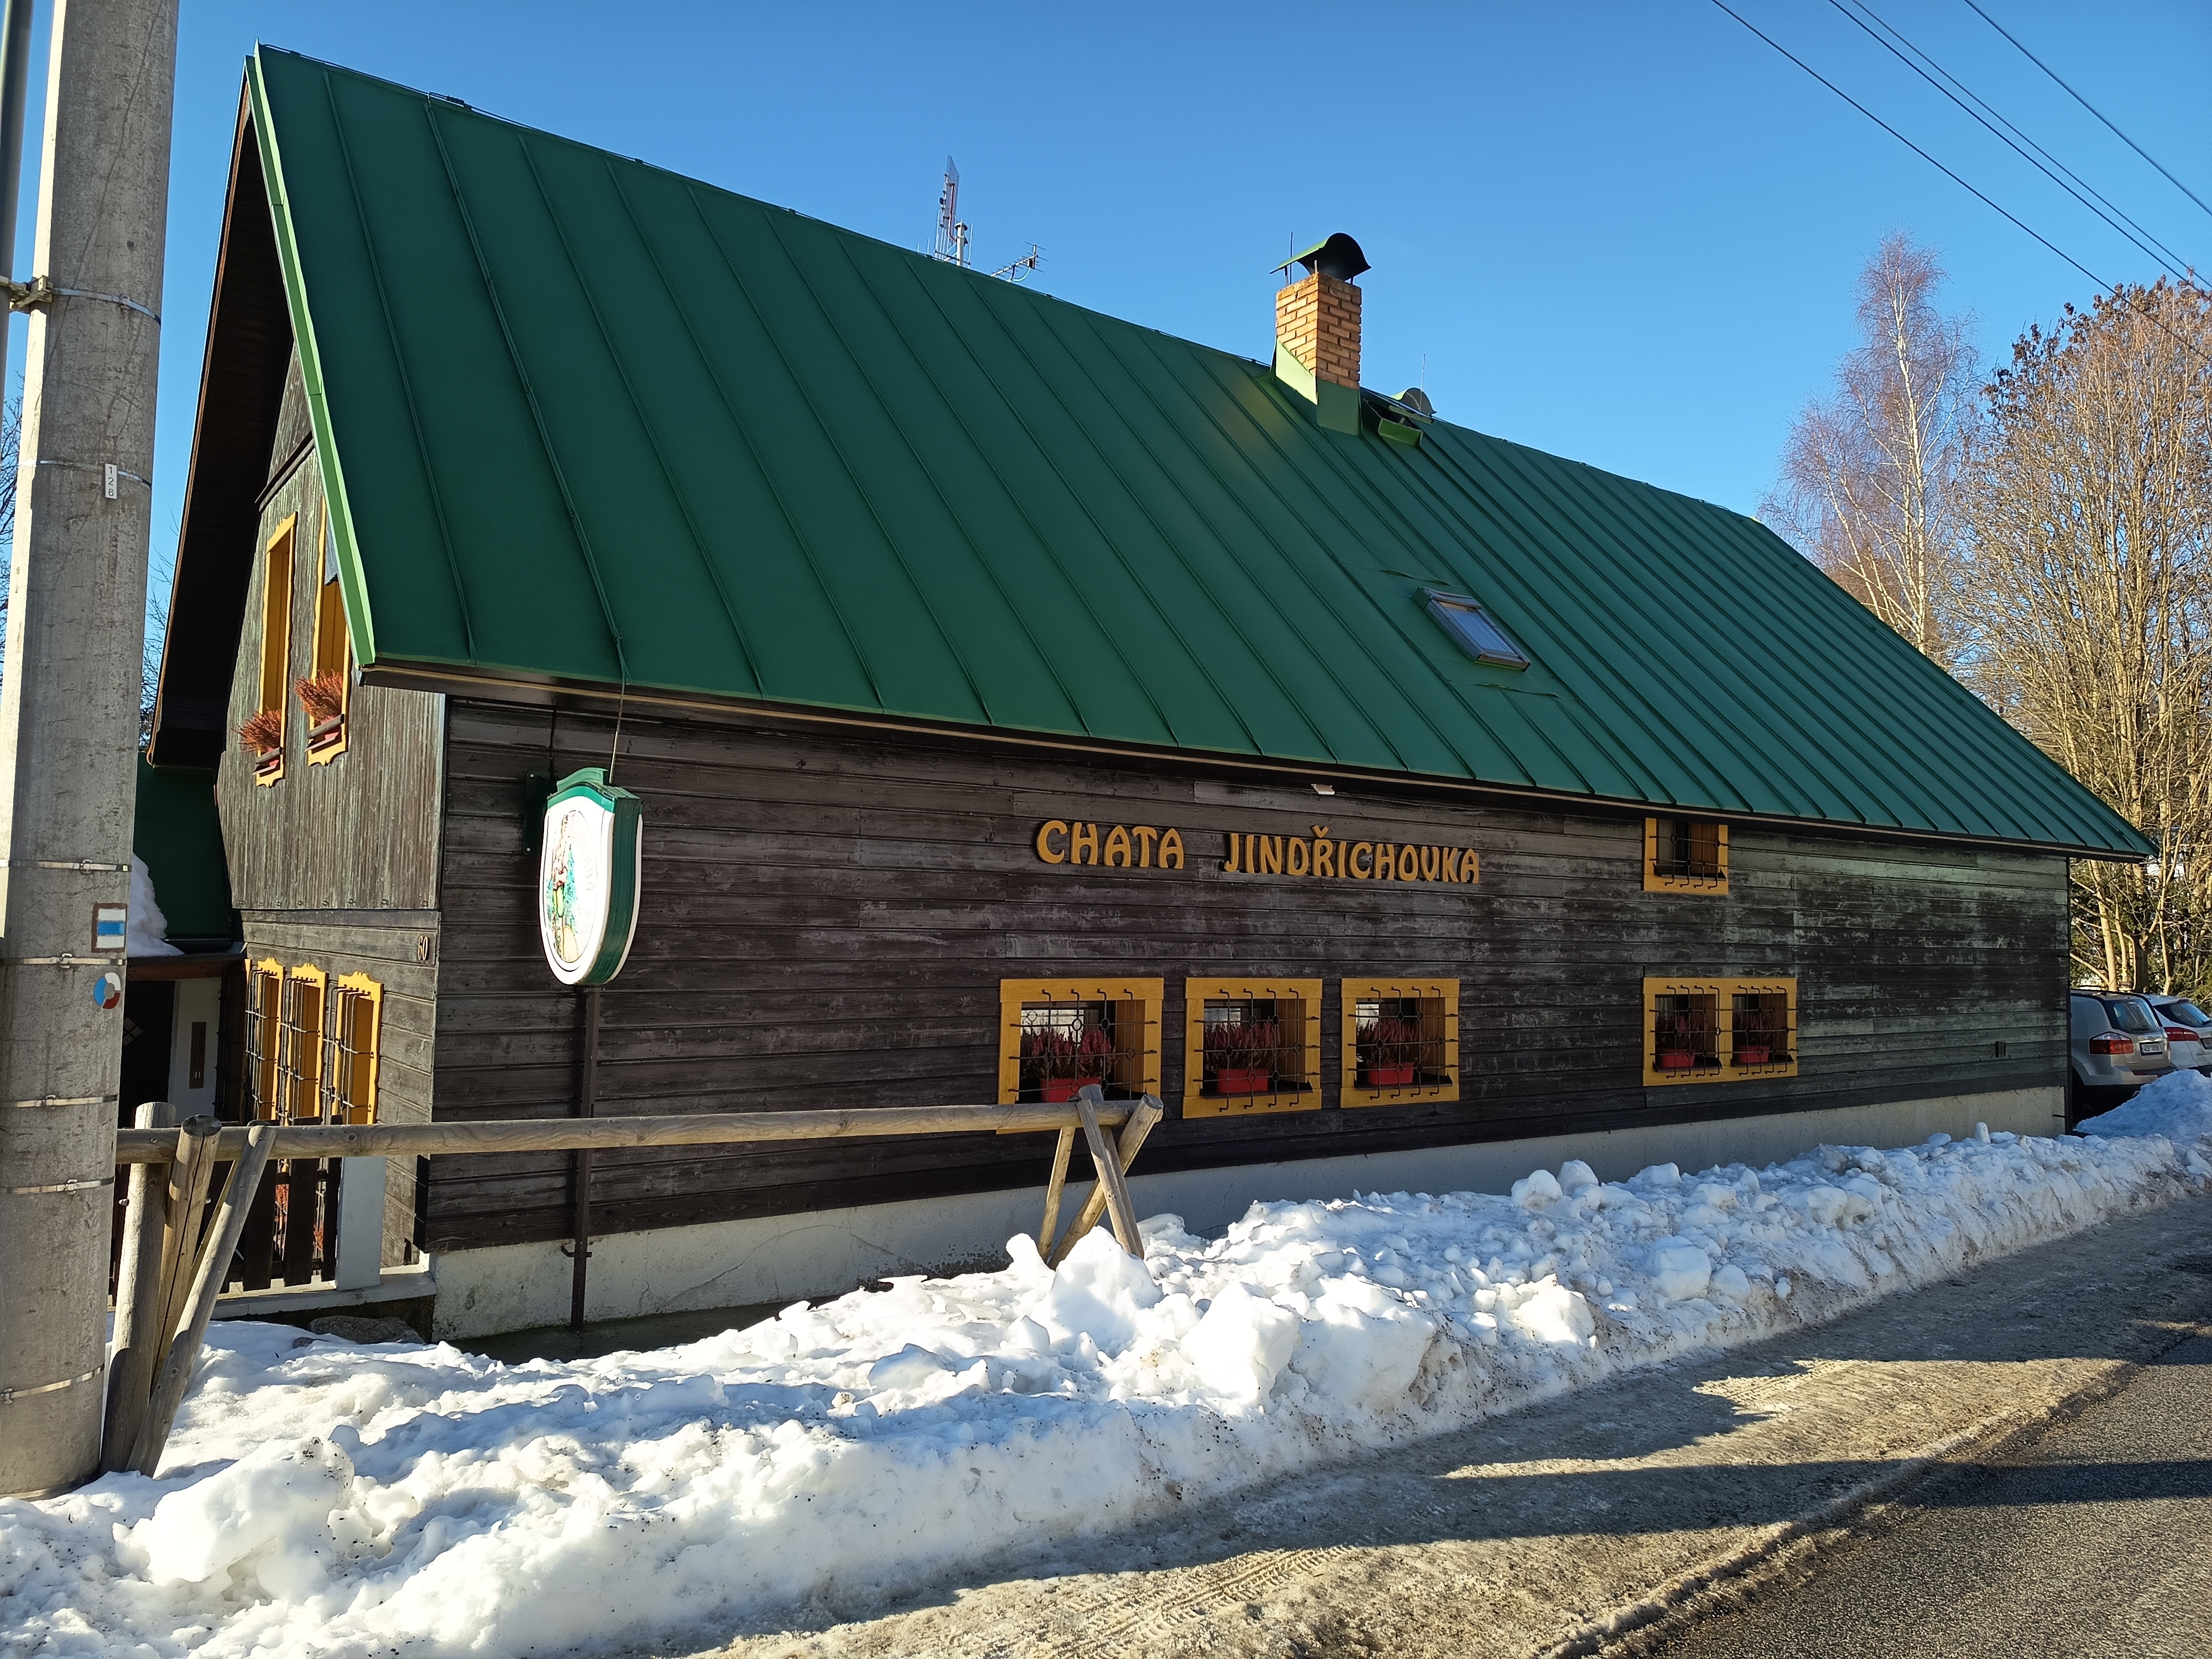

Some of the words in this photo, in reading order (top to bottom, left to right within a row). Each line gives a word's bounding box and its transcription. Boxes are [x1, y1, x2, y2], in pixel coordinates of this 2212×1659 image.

[1036, 820, 1185, 869] CHATA
[1223, 825, 1480, 884] JINDŘICHOVKA
[418, 936, 428, 961] 60
